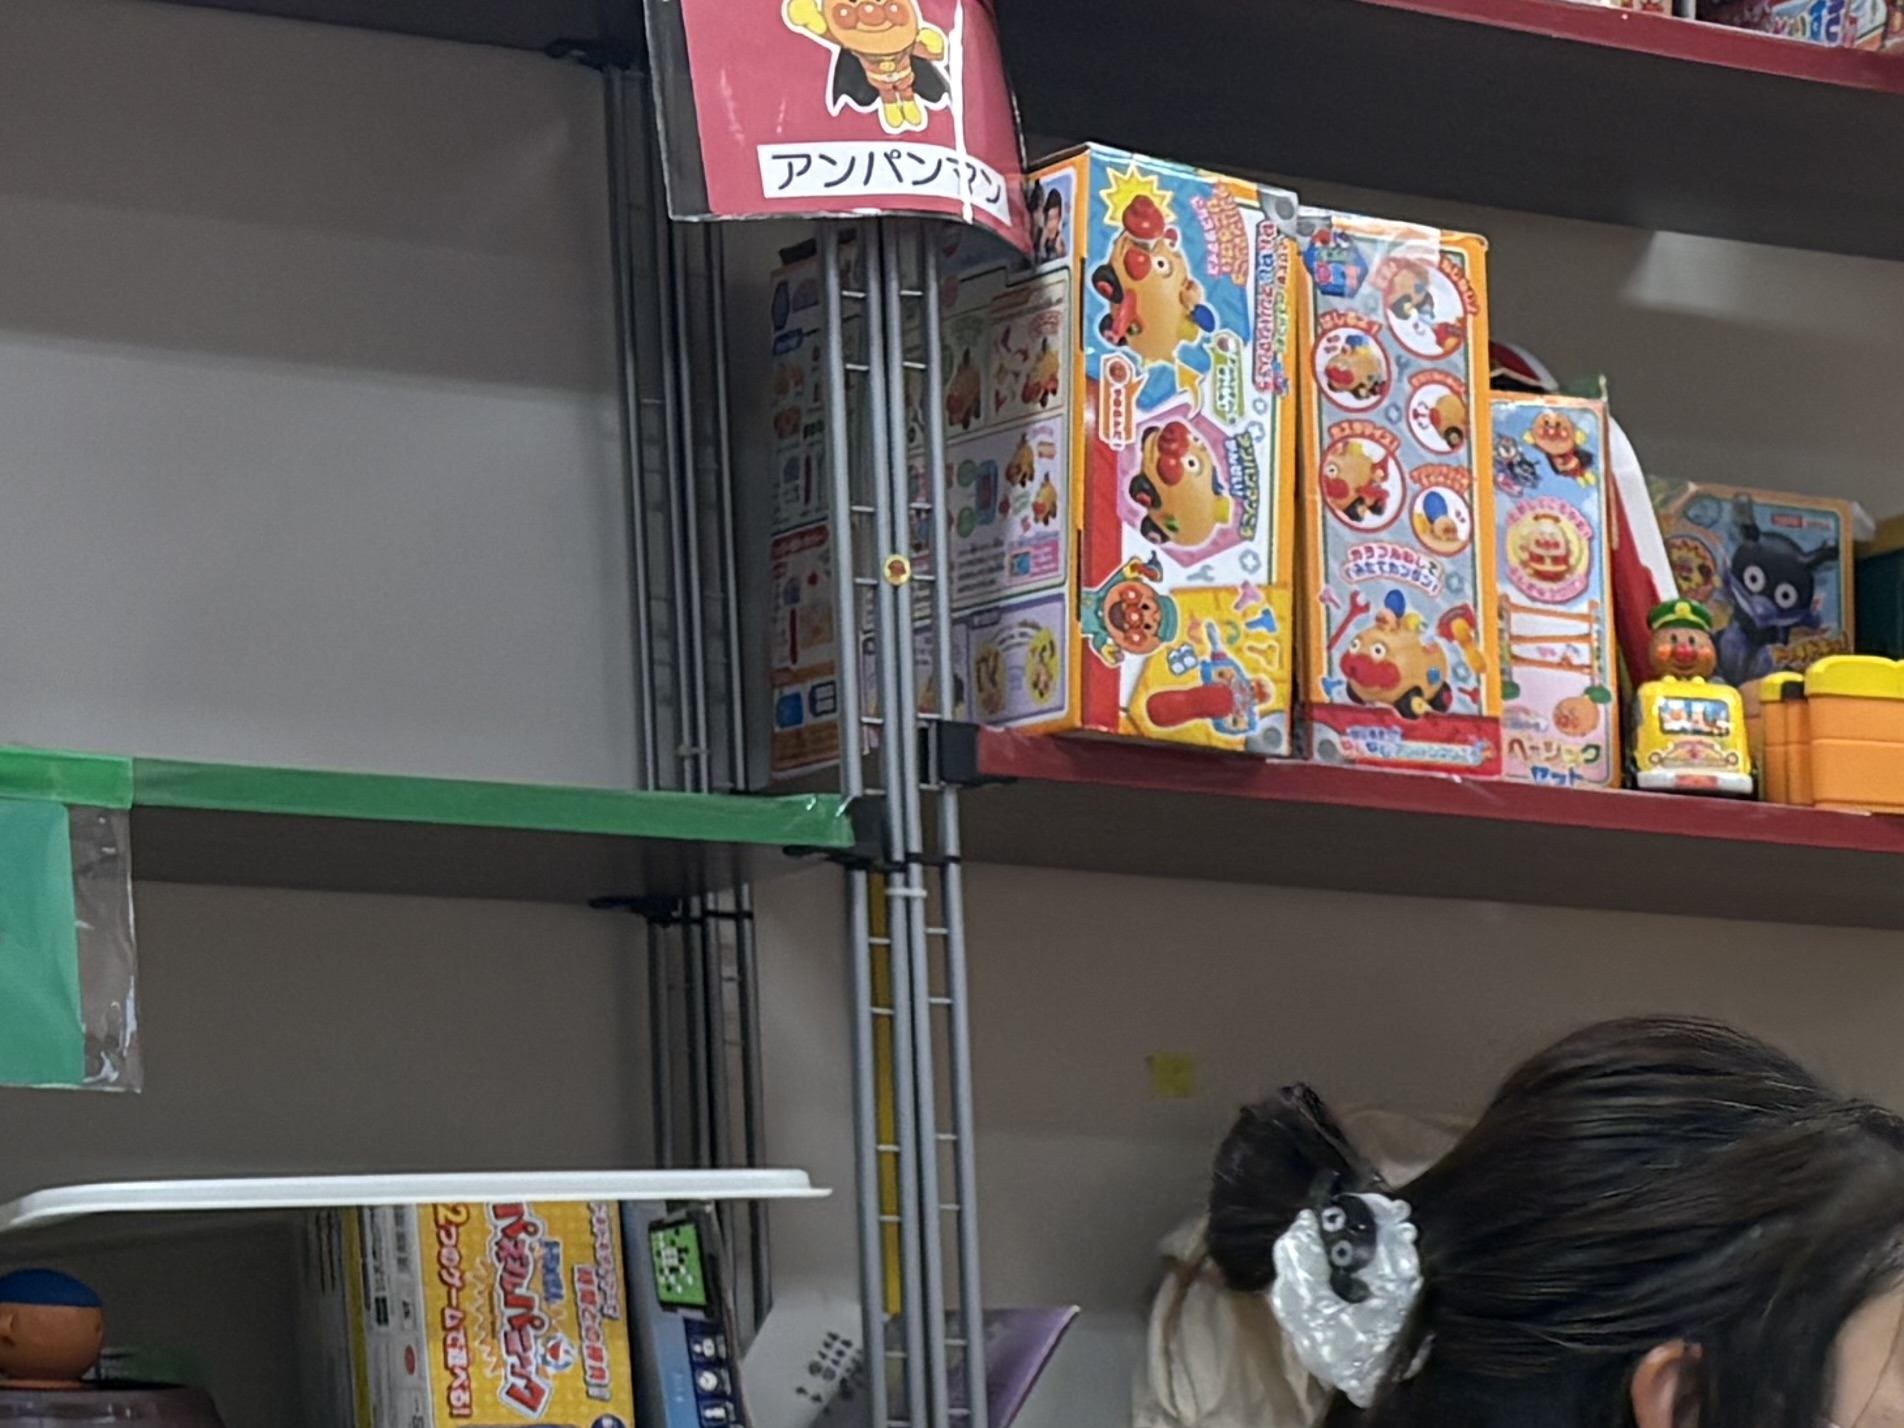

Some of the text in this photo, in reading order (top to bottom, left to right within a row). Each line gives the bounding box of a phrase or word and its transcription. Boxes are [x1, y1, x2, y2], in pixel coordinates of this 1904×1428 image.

[770, 147, 1002, 205] アンパンマン
